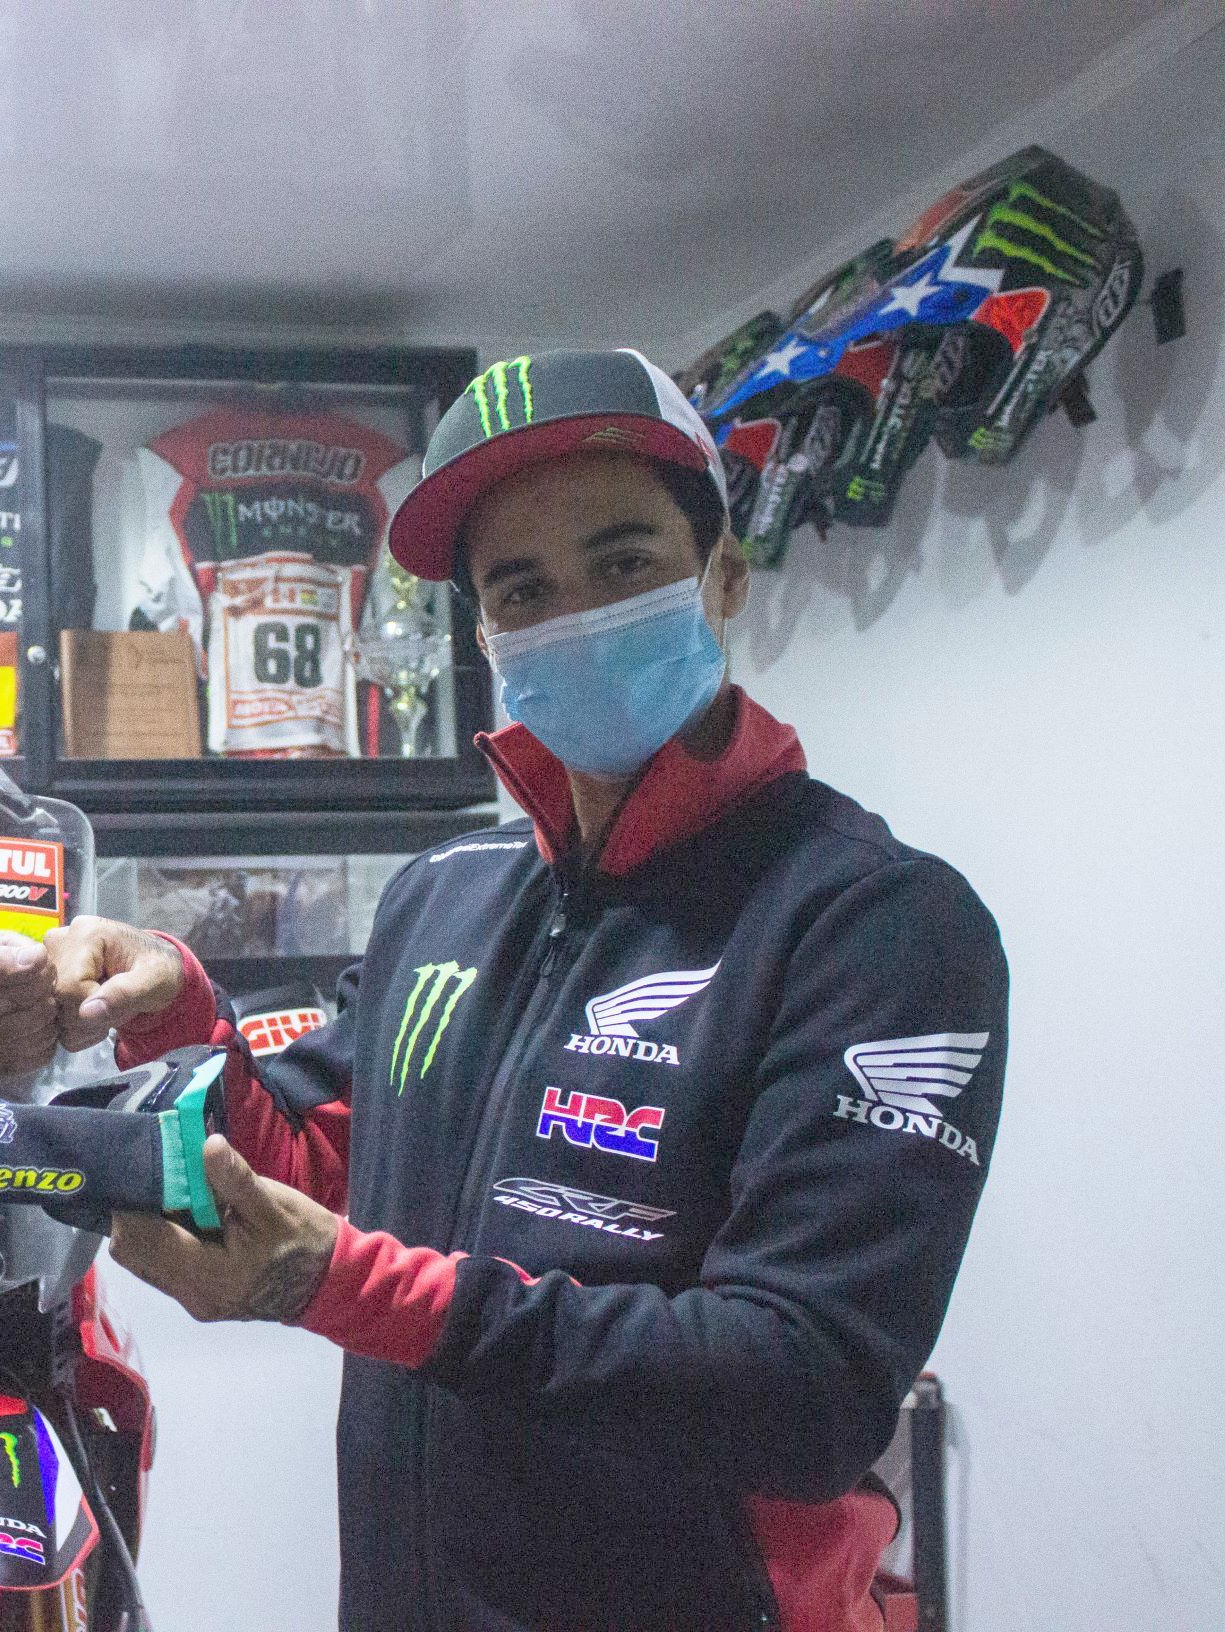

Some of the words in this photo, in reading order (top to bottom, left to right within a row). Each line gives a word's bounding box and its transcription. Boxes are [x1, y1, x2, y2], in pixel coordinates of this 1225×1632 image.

[207, 439, 367, 485] CORNEJO
[254, 621, 323, 689] 68
[563, 1033, 681, 1065] HONDA
[535, 1086, 666, 1163] HRC
[832, 1094, 981, 1167] HONDA
[492, 1177, 678, 1222] CRF
